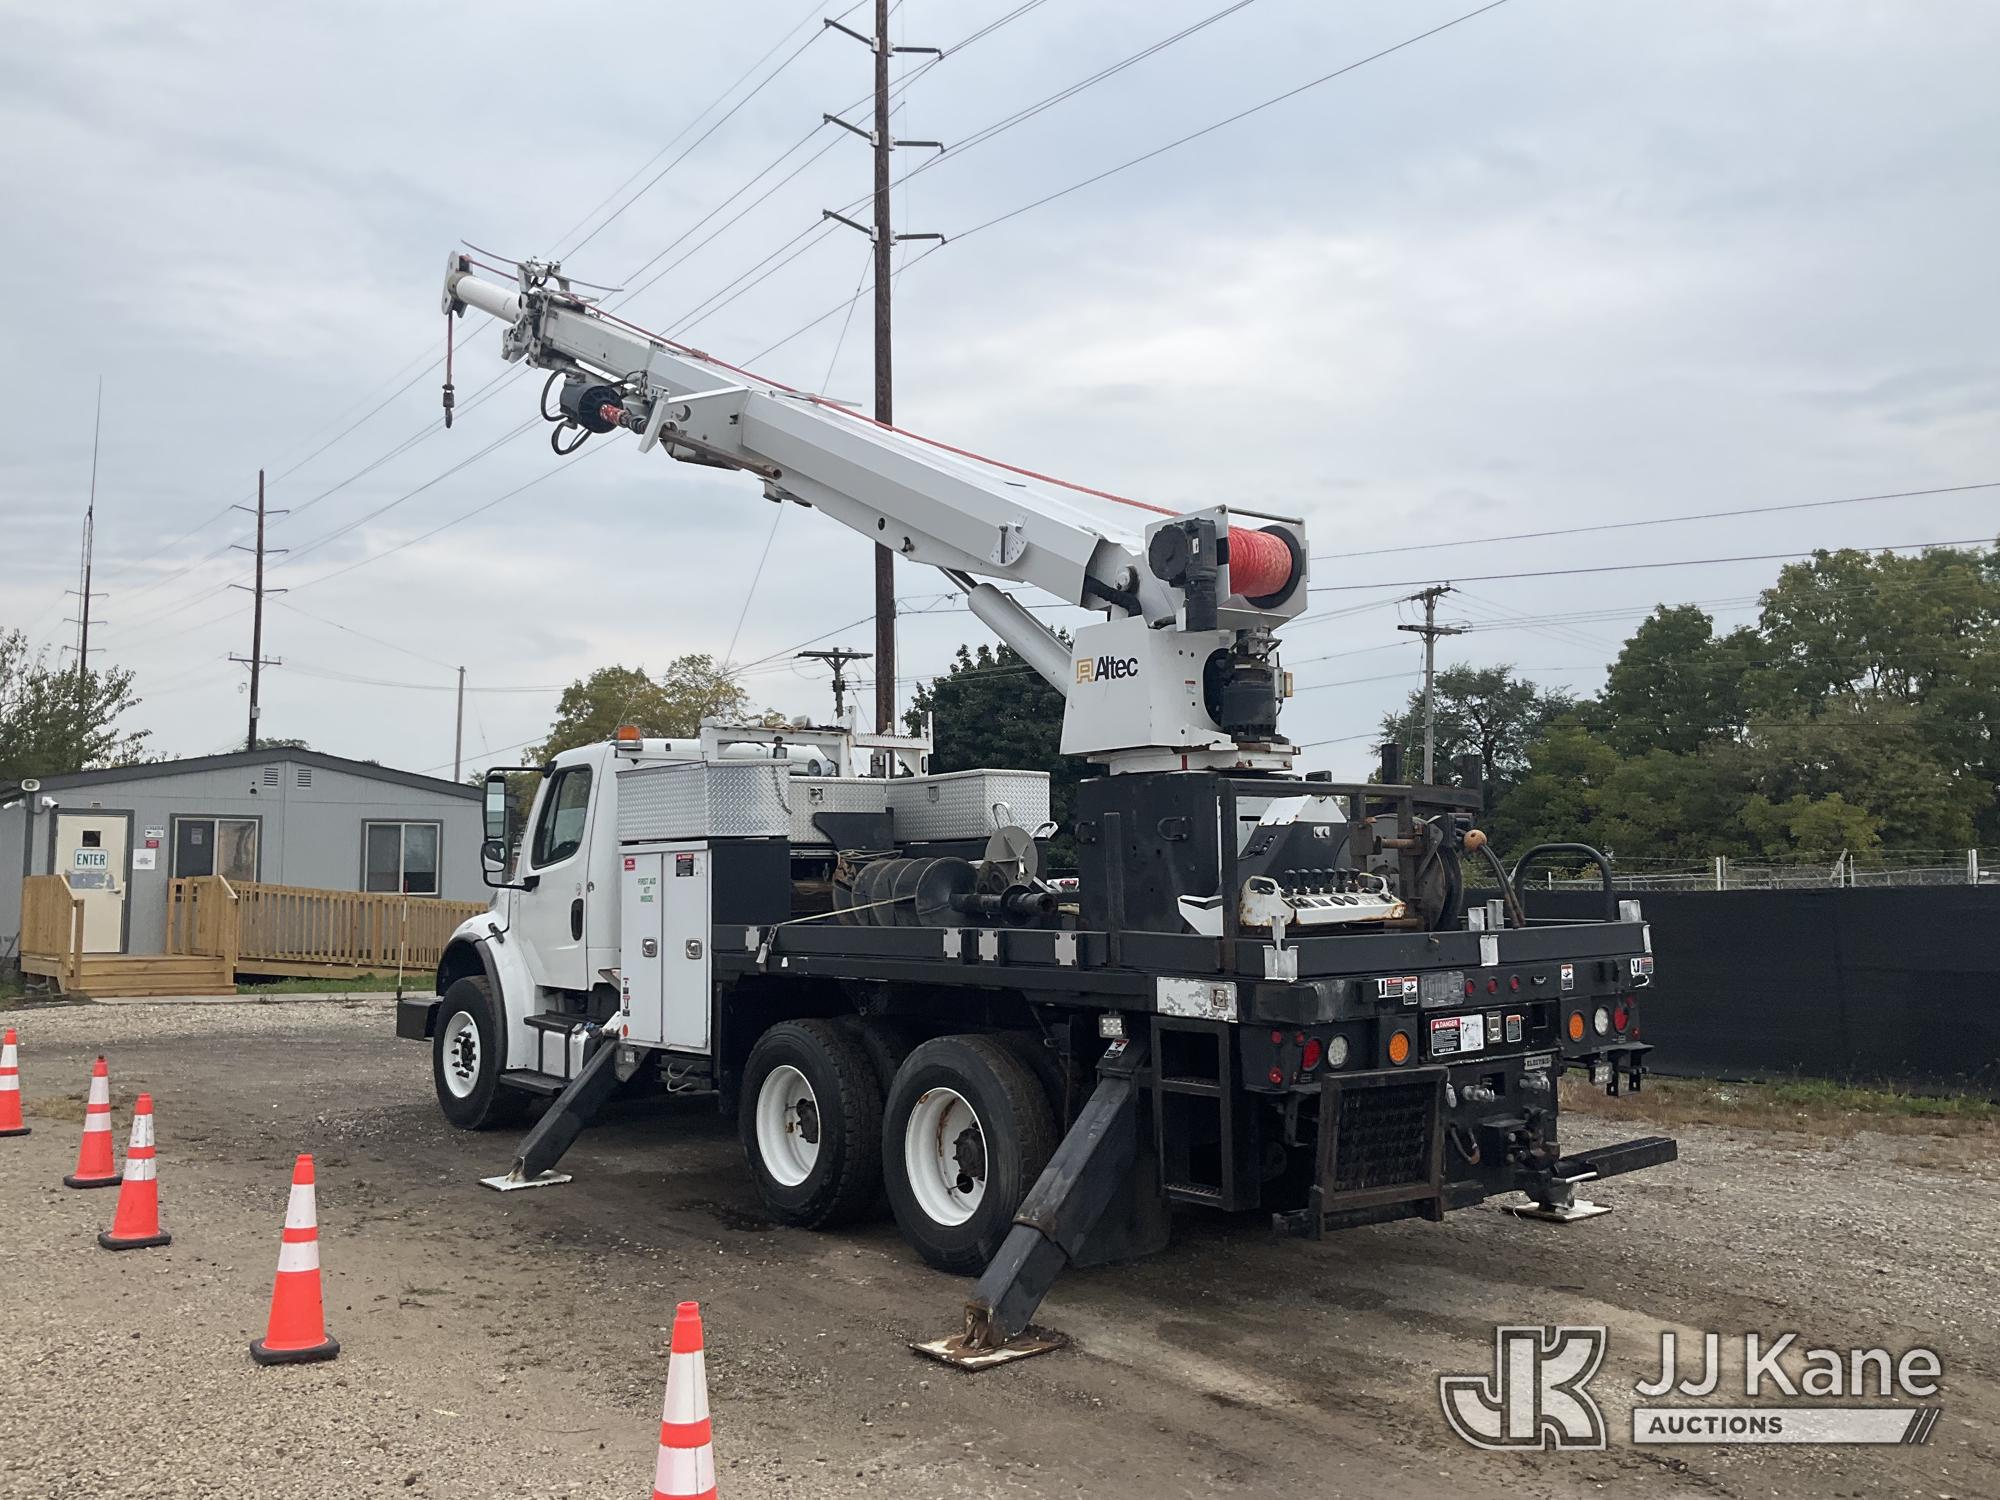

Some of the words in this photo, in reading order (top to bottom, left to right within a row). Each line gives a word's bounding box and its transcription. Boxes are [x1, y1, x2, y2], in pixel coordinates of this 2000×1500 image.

[1094, 655, 1139, 682] Altec
[76, 853, 106, 866] ENTER
[1439, 1019, 1458, 1028] DANGER
